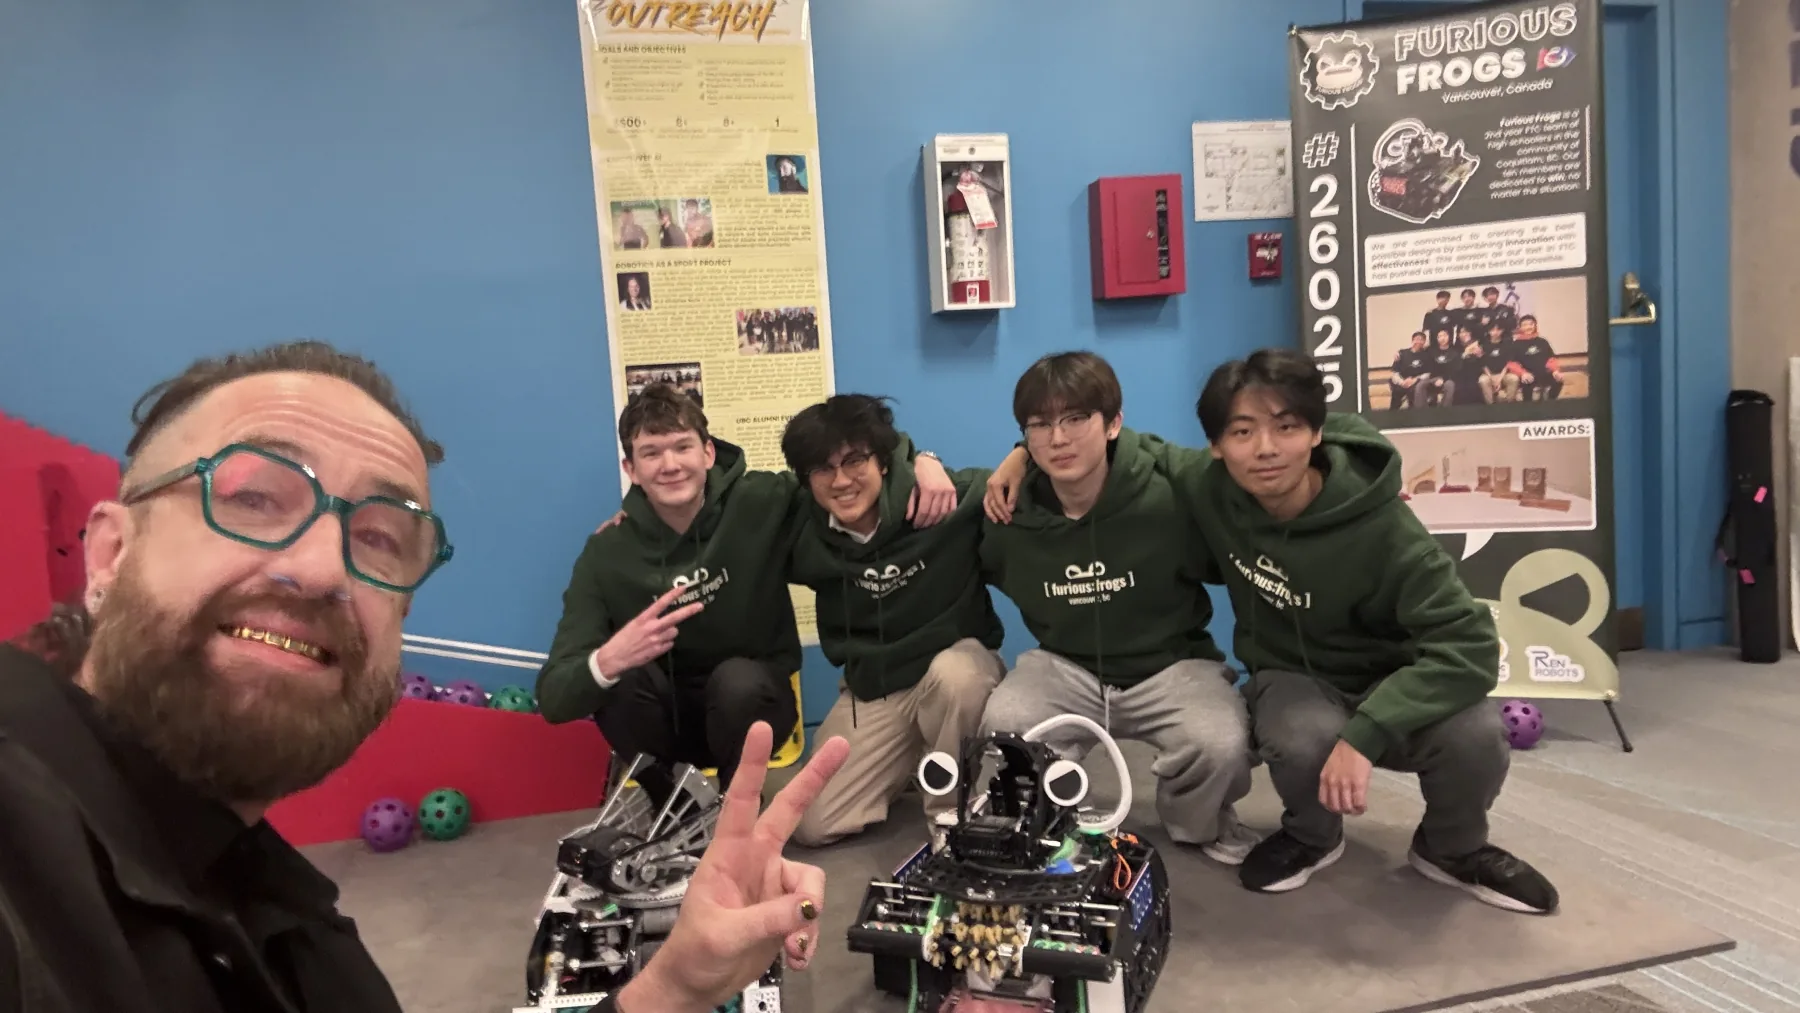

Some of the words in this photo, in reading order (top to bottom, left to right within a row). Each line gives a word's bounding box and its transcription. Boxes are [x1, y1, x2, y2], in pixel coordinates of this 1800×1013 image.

[606, 0, 776, 43] OUTREACH
[1394, 2, 1577, 62] FURIOUS
[1396, 48, 1526, 95] FROGS
[1442, 86, 1504, 103] Vancouver,
[1506, 78, 1554, 94] Canada
[1503, 128, 1524, 138] year
[1543, 122, 1568, 132] team
[1569, 118, 1580, 128] of
[1554, 132, 1562, 140] in
[1564, 130, 1580, 140] the
[1517, 142, 1568, 156] community
[1570, 139, 1580, 149] of
[1520, 164, 1563, 175] members
[1564, 162, 1581, 170] are
[1489, 176, 1534, 189] dedicated
[1536, 176, 1546, 184] to
[1568, 172, 1582, 180] no
[1490, 188, 1522, 200] matter
[1522, 187, 1538, 196] the
[1372, 242, 1385, 250] We
[1393, 240, 1408, 248] are
[1470, 232, 1479, 240] to
[1372, 250, 1406, 261] possible
[1408, 247, 1441, 257] designs
[1444, 246, 1454, 254] by
[1505, 236, 1555, 246] innovation
[674, 260, 698, 268] SPORT
[700, 258, 732, 267] PROJECT
[1372, 272, 1388, 280] has
[1389, 268, 1422, 280] pushed
[1423, 268, 1433, 276] us
[1434, 266, 1444, 274] to
[1446, 263, 1470, 273] make
[1472, 262, 1486, 270] the
[1488, 260, 1507, 268] best
[753, 415, 780, 423] ALUMNI
[1523, 424, 1590, 438] AWARDS:
[1052, 577, 1127, 596] furious:frogs
[1535, 668, 1579, 678] ROBOTS
